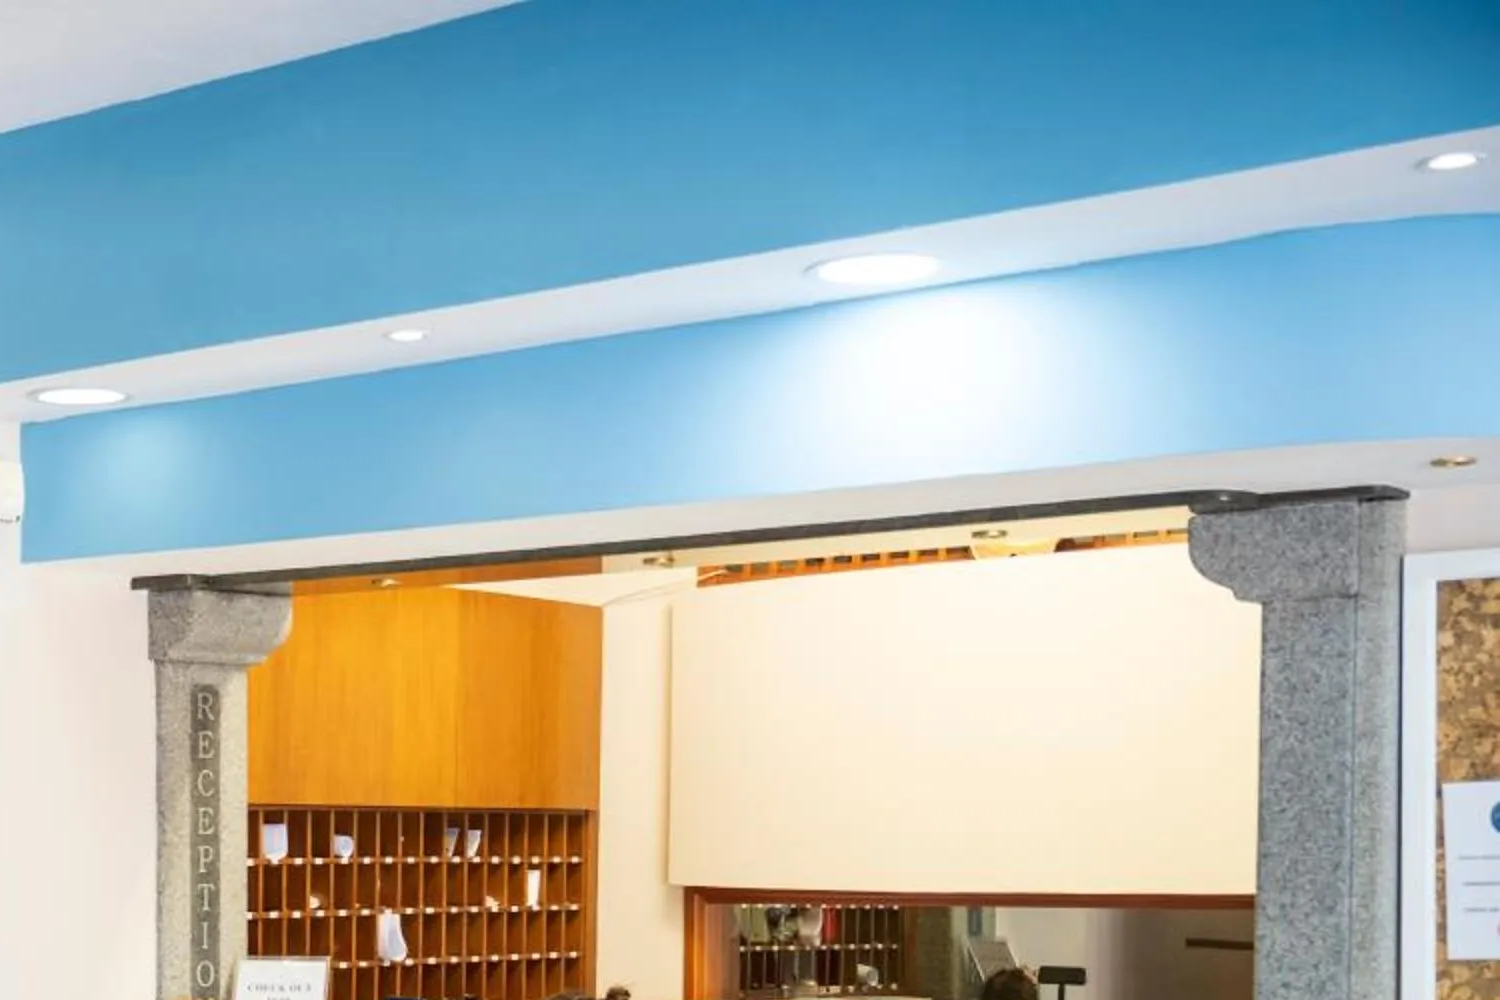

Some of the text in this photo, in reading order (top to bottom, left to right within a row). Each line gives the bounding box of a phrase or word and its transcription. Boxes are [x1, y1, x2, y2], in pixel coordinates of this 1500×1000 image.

[197, 692, 214, 987] RECEPTIO
[247, 983, 312, 993] CHECK OUT
